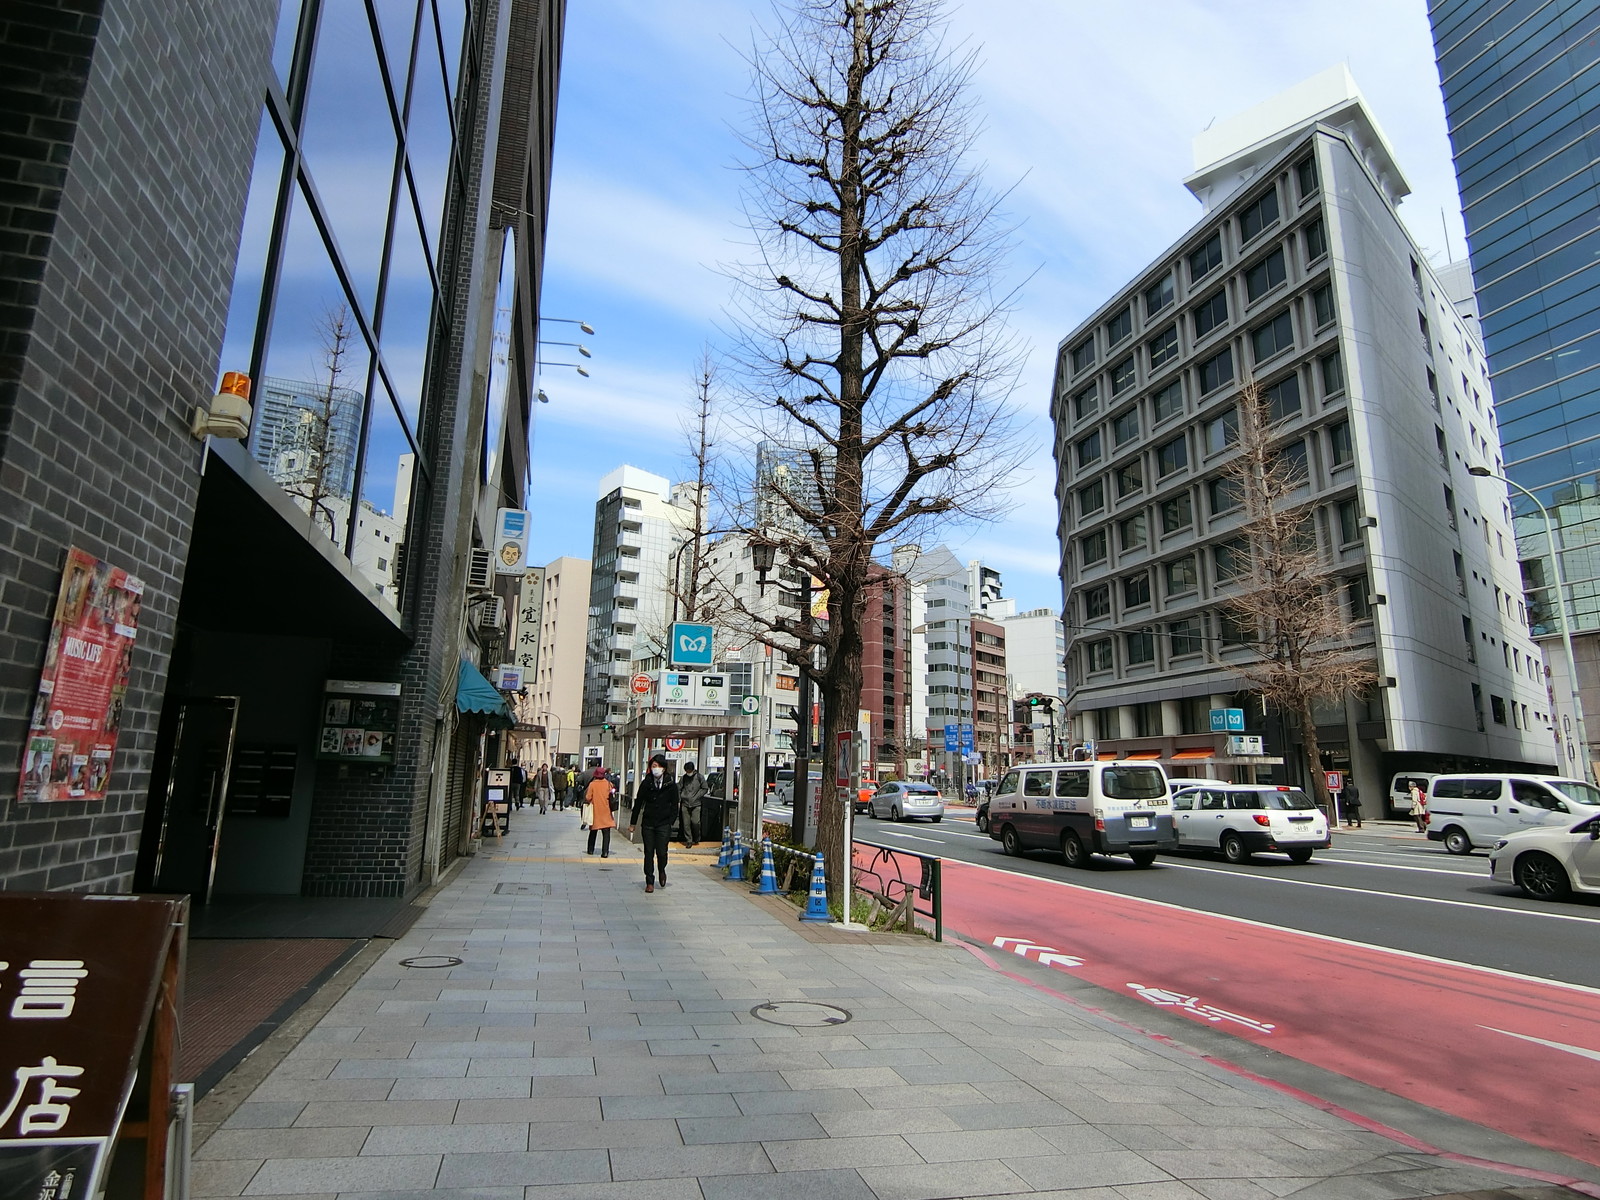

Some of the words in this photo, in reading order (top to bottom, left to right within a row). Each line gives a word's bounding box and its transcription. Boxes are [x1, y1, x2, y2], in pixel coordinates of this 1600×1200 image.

[64, 636, 87, 660] MUSIC
[86, 642, 104, 664] LIFE
[0, 1055, 85, 1136] 店
